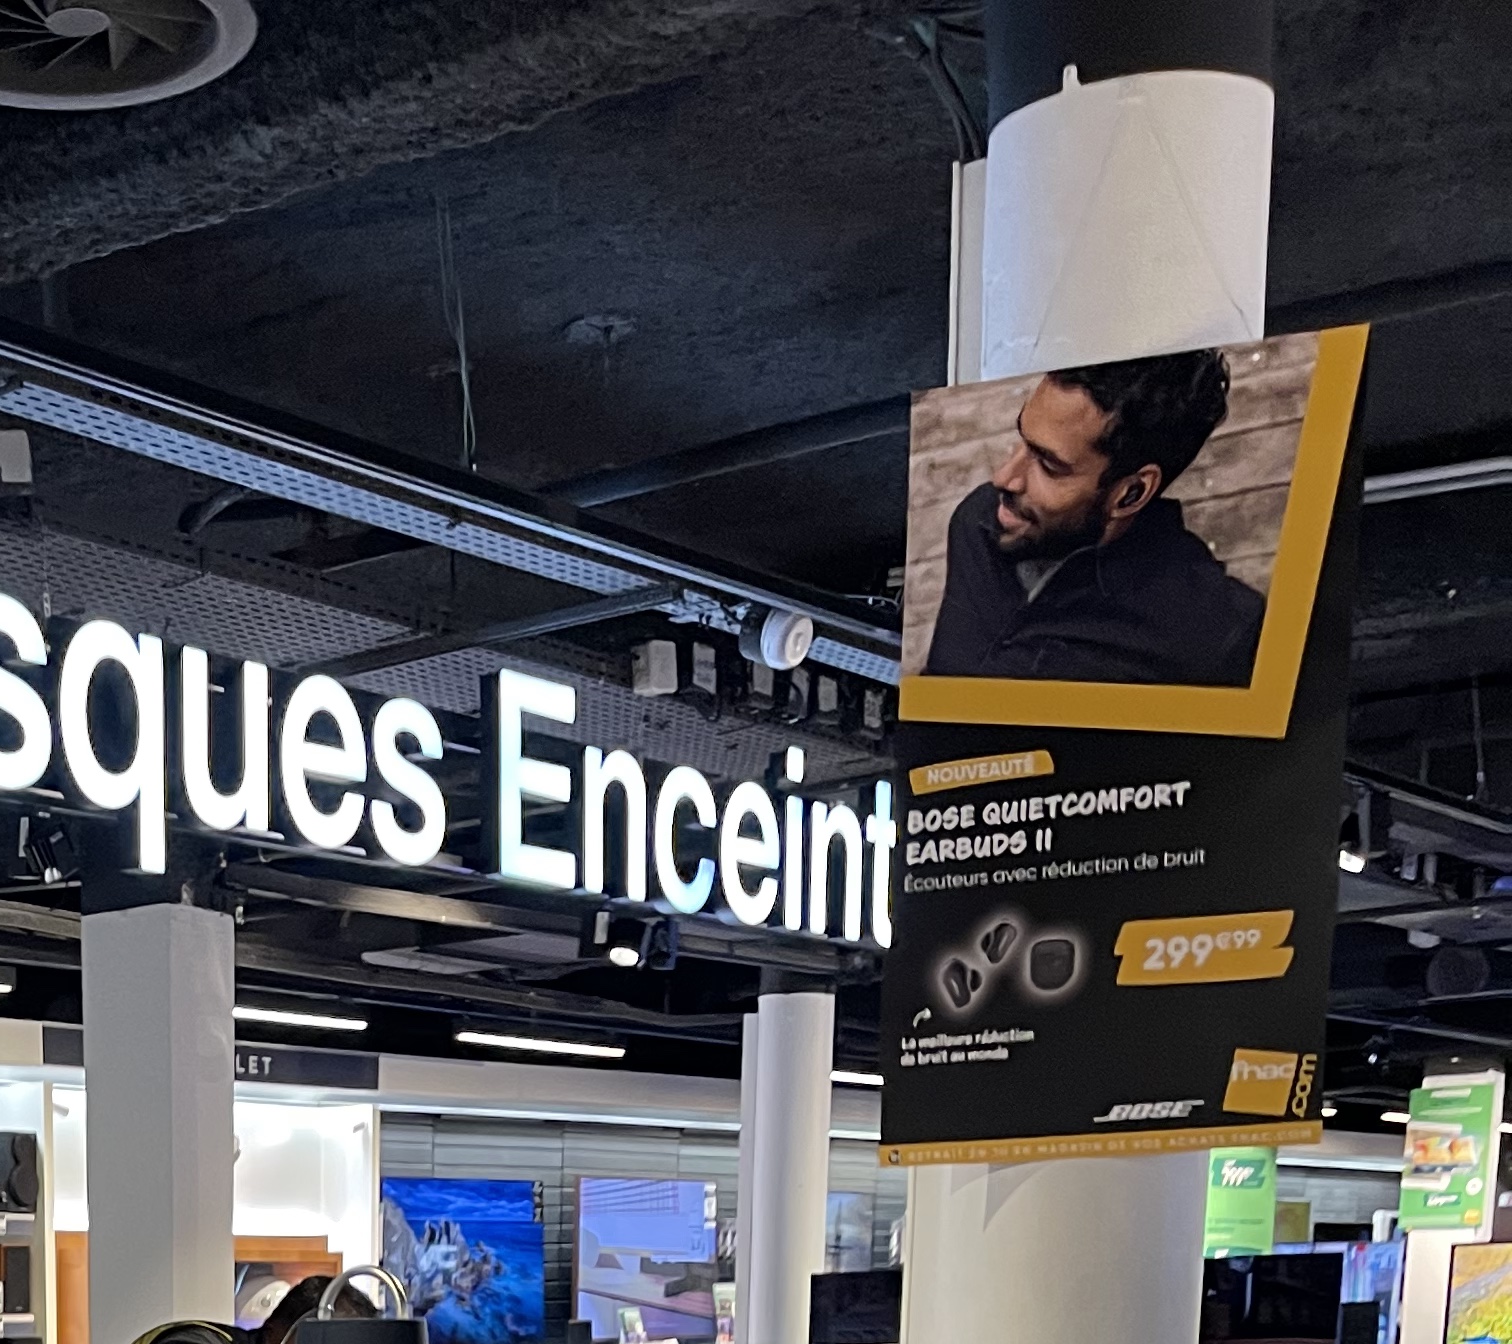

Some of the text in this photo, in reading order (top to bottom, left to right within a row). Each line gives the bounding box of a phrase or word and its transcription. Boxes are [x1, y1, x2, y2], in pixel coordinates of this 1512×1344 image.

[926, 755, 1035, 784] NOUVEAUTÉ
[498, 668, 897, 949] Enceint
[907, 780, 1191, 835] BOSE QUIETCOMFORT
[906, 828, 1053, 866] EARBUDS II
[903, 848, 1207, 894] Écouteurs avec réduction de bruit
[1230, 1058, 1296, 1083] fnac
[1093, 1099, 1206, 1124] BOSE
